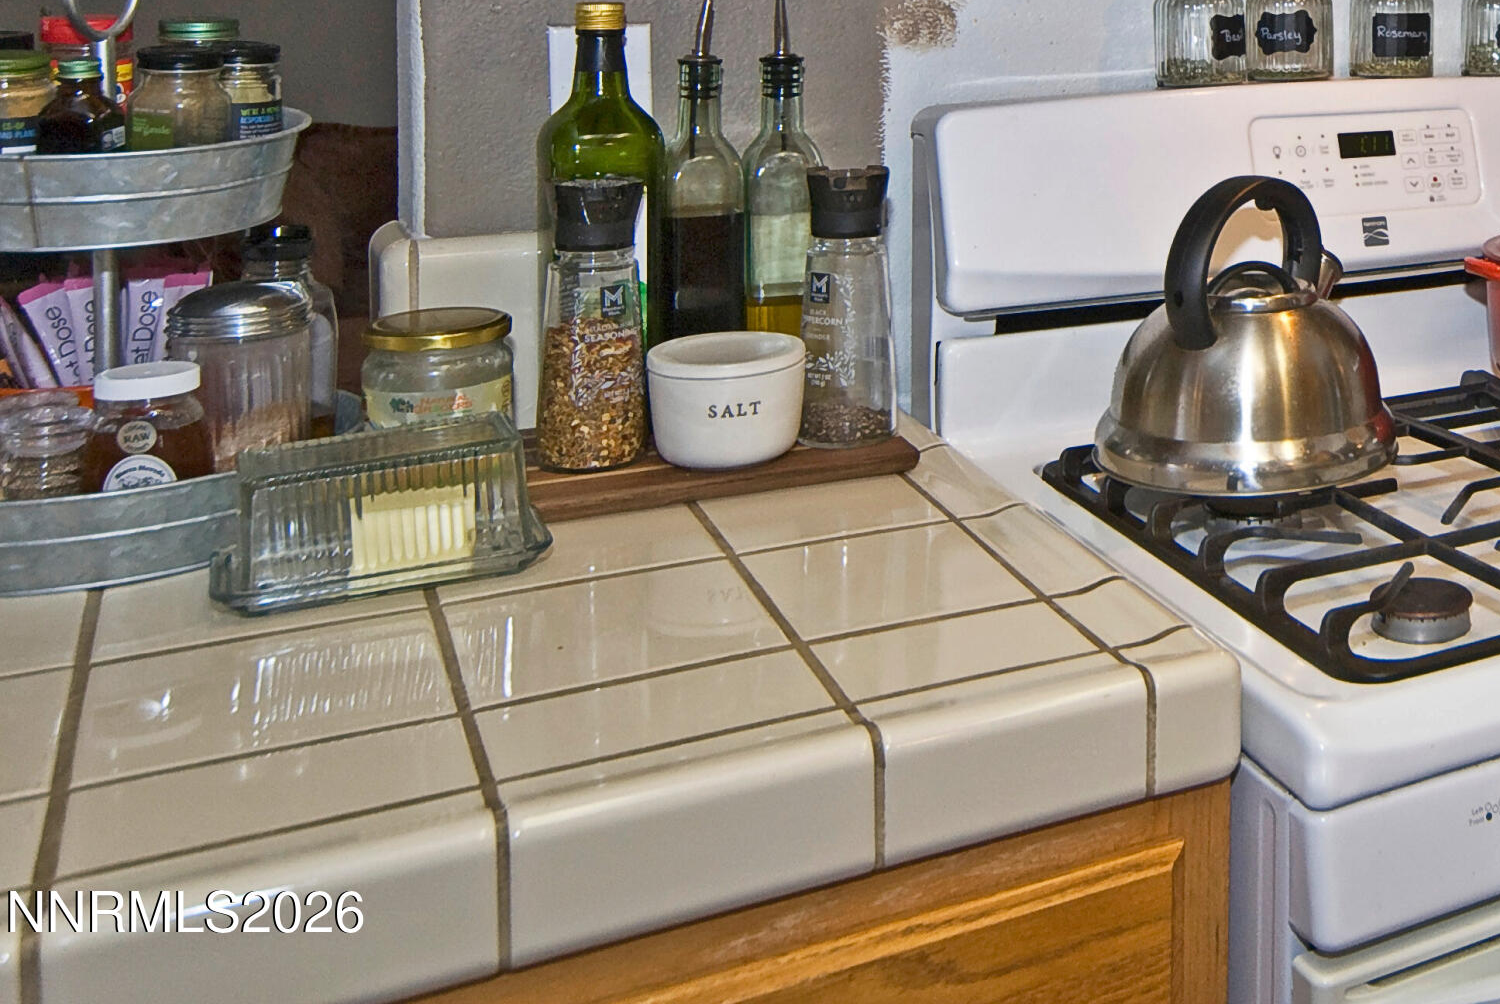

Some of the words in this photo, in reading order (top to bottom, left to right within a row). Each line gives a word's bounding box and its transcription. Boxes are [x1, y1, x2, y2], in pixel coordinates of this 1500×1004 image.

[1260, 27, 1302, 46] Parsley
[1376, 25, 1428, 44] Rosemary
[45, 305, 77, 359] Dose
[707, 400, 762, 419] SALT
